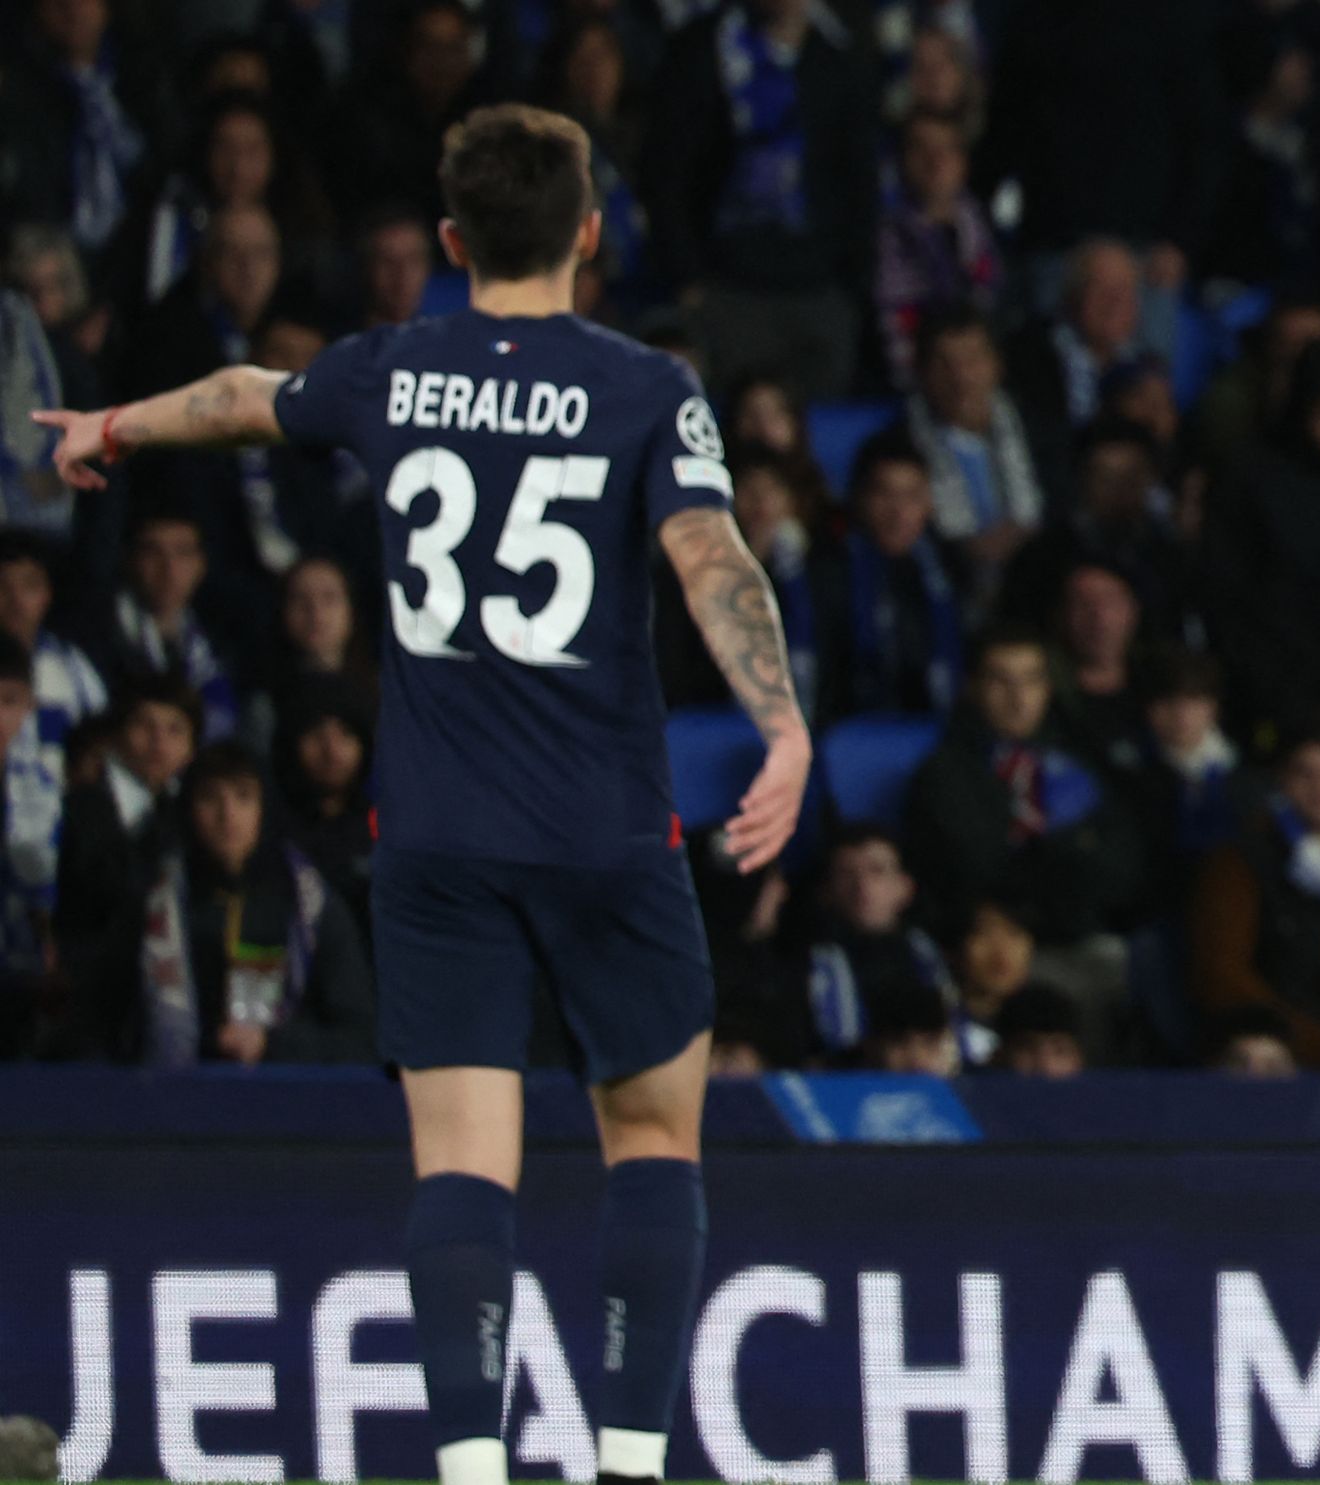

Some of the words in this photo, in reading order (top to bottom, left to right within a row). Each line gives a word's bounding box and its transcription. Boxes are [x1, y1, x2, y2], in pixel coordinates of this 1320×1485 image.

[387, 369, 589, 438] BERALDO
[385, 446, 610, 668] 35
[604, 1297, 627, 1373] PARIS
